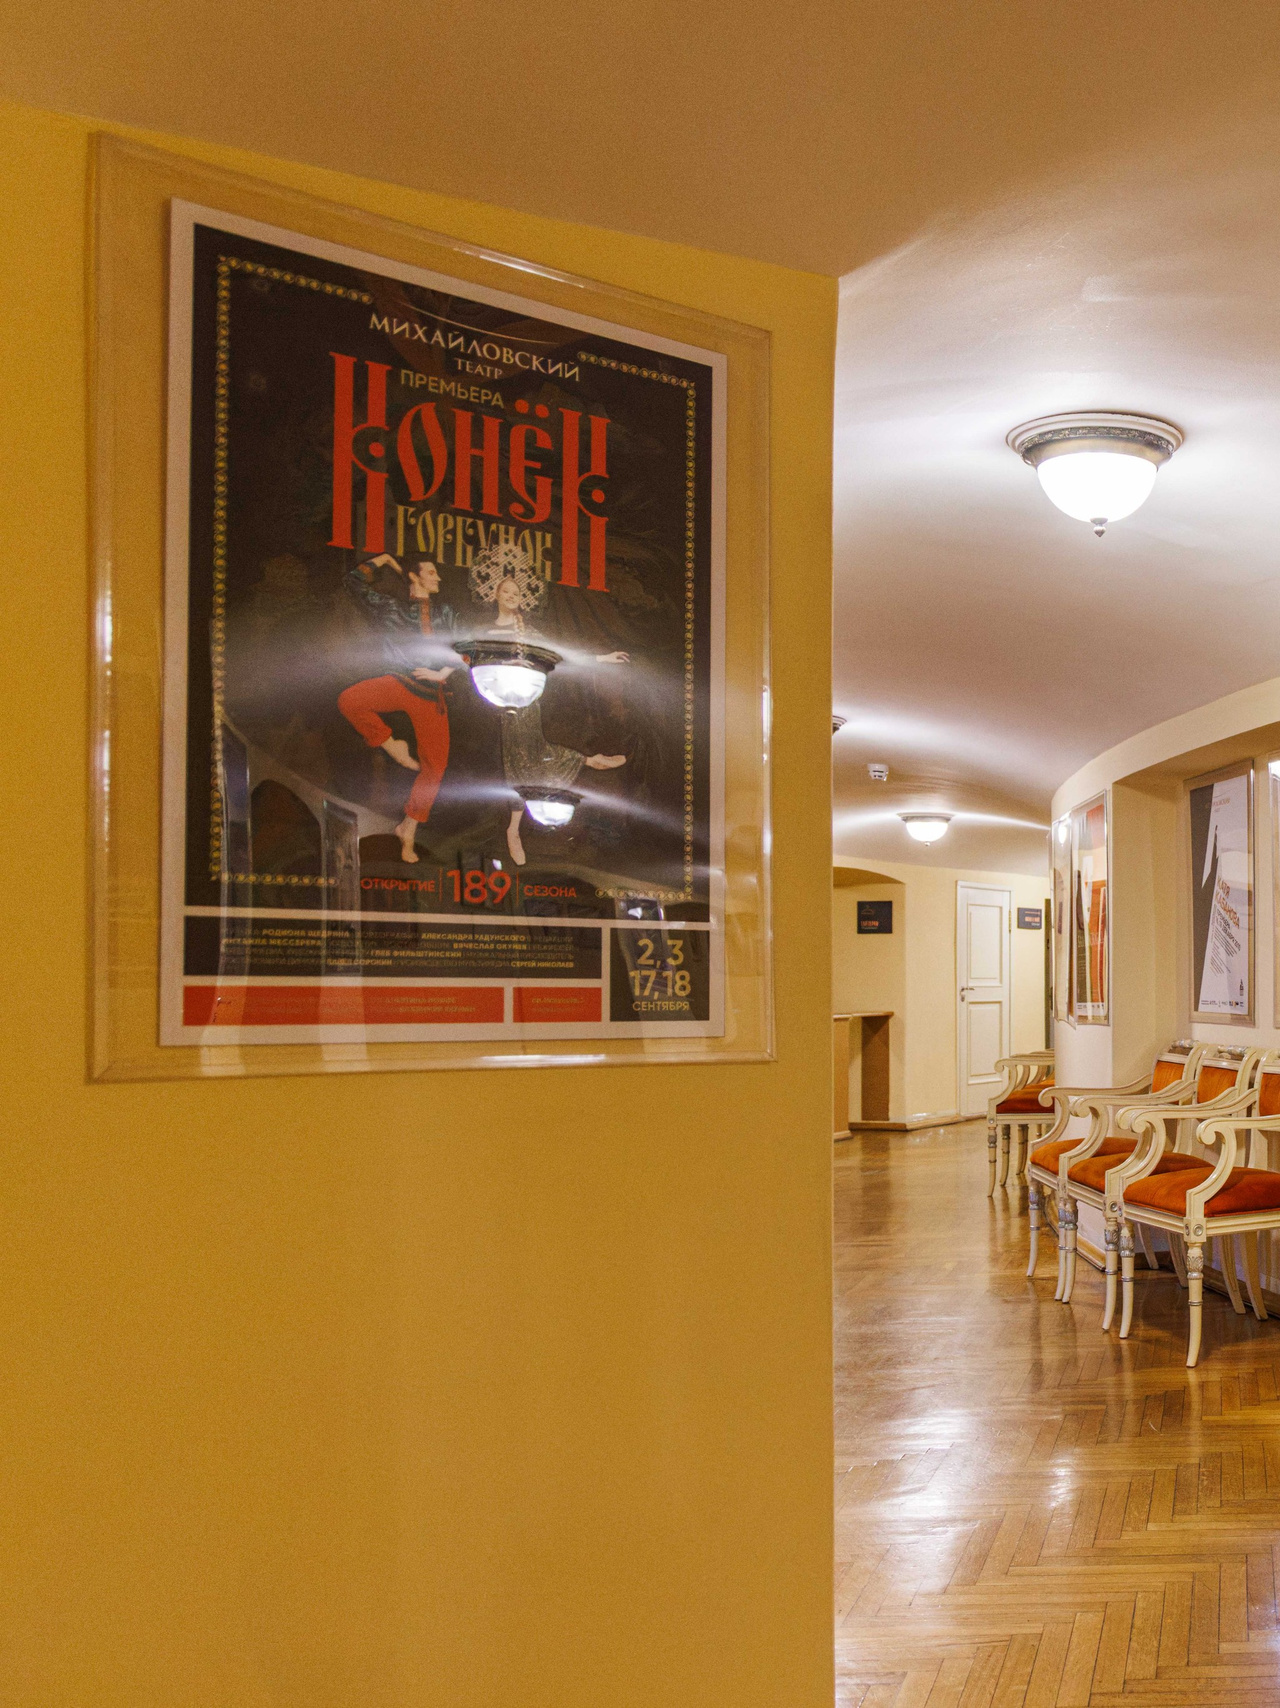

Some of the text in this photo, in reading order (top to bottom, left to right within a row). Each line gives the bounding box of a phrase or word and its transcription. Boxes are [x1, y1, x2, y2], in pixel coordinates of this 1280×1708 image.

[369, 313, 580, 382] МИХАЙЛОВСКИЙ
[454, 357, 503, 380] ТЕАТР
[400, 369, 505, 408] ПРЕМЬЕРА
[327, 351, 611, 592] КОНЁК
[360, 869, 577, 904] ОТКРЫТИЕ 189 СЕЗОНА
[632, 1001, 690, 1012] СЕНТЯБРЯ
